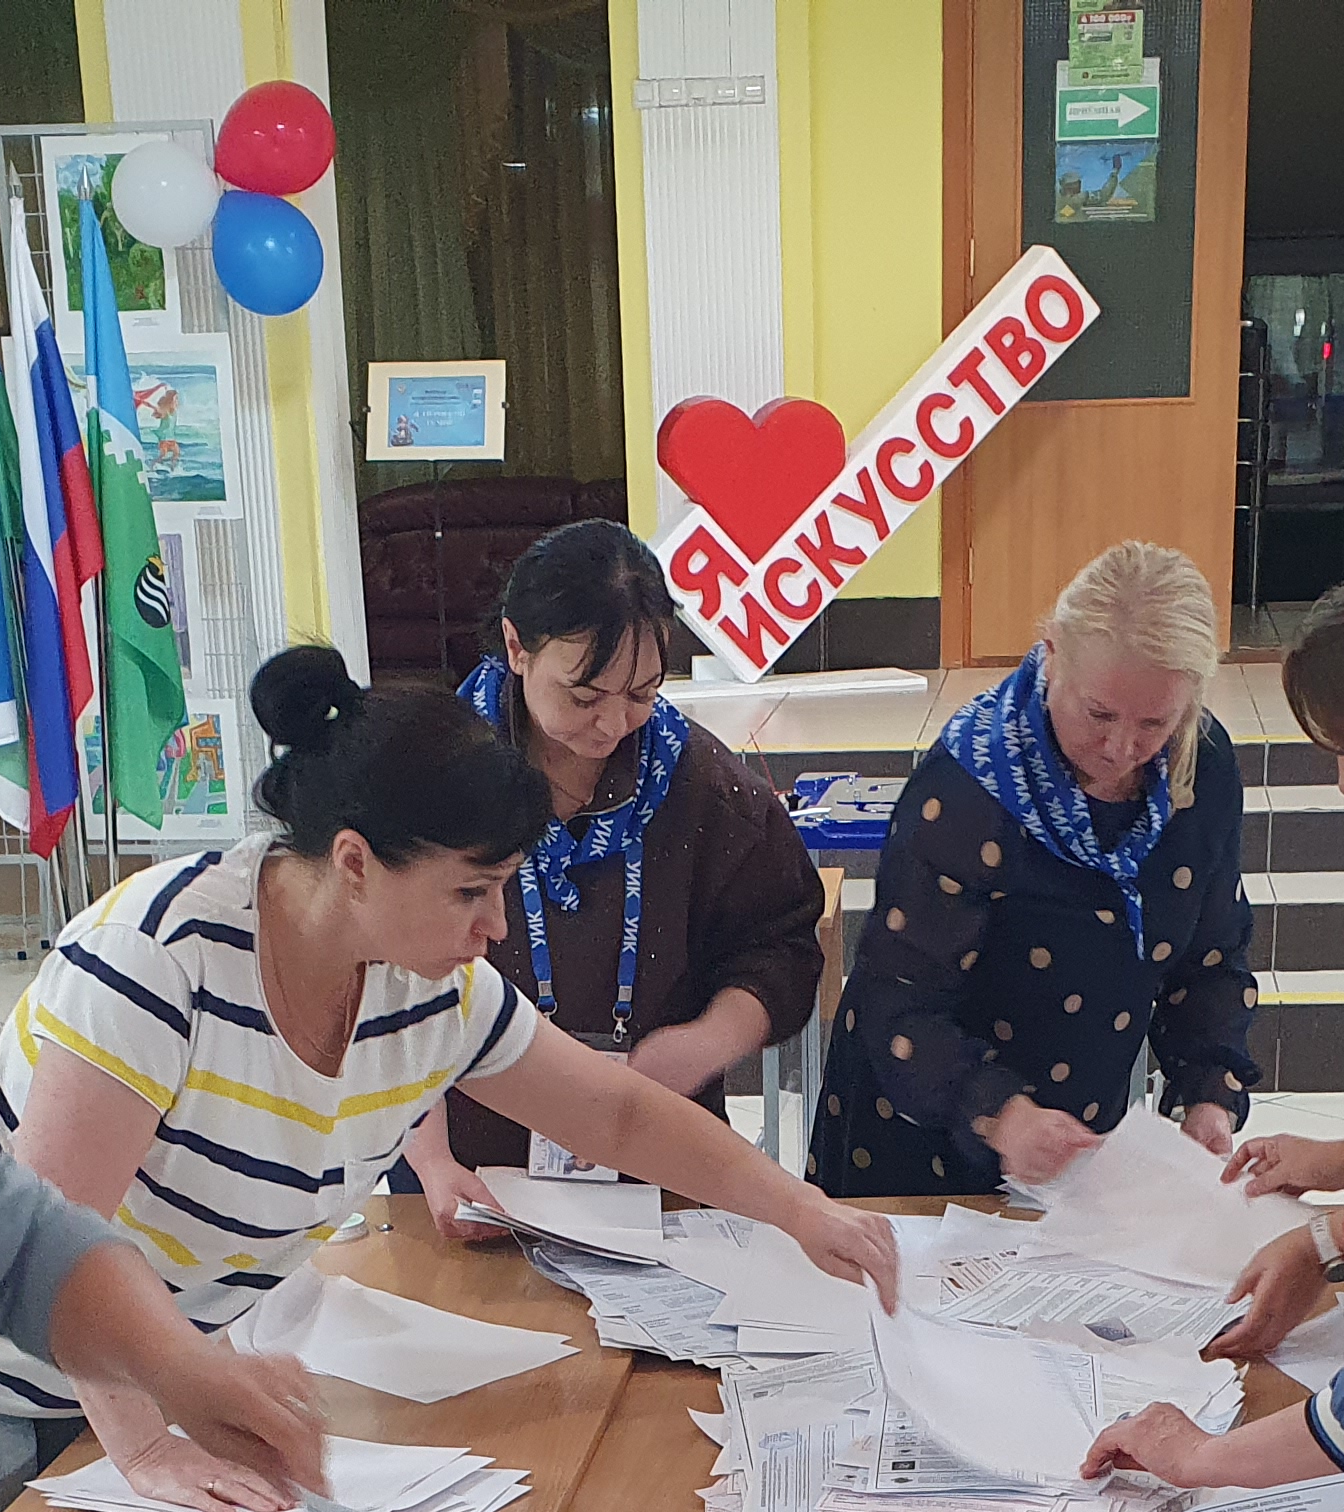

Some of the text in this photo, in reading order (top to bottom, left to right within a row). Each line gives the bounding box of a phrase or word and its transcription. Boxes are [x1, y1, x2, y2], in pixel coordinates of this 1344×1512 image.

[717, 275, 1084, 669] ИСКУССТВО
[670, 526, 748, 621] Я
[589, 818, 613, 858] УИК
[526, 910, 546, 949] УИК
[622, 860, 641, 954] УИК УИК
